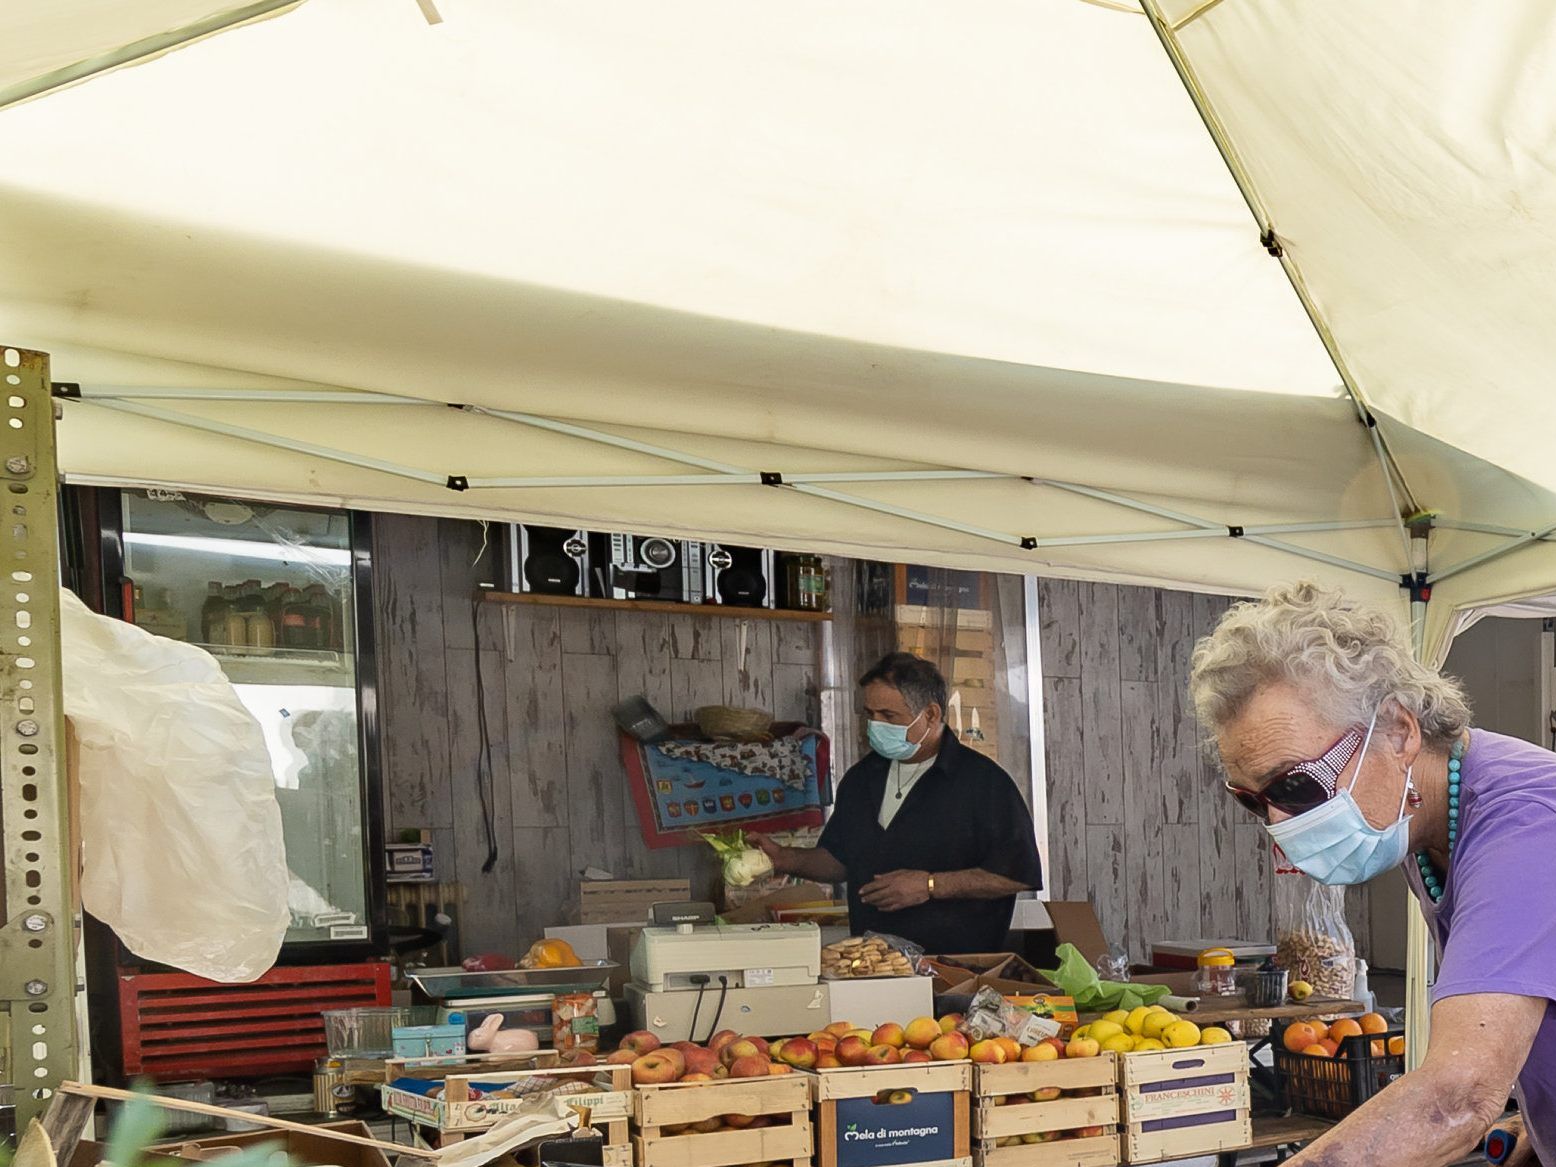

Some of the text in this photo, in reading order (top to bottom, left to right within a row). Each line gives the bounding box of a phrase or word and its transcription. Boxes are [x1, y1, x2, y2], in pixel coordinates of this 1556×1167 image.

[1145, 1087, 1215, 1104] FRANCESCHINI
[876, 1127, 887, 1139] di
[888, 1125, 939, 1138] montagna
